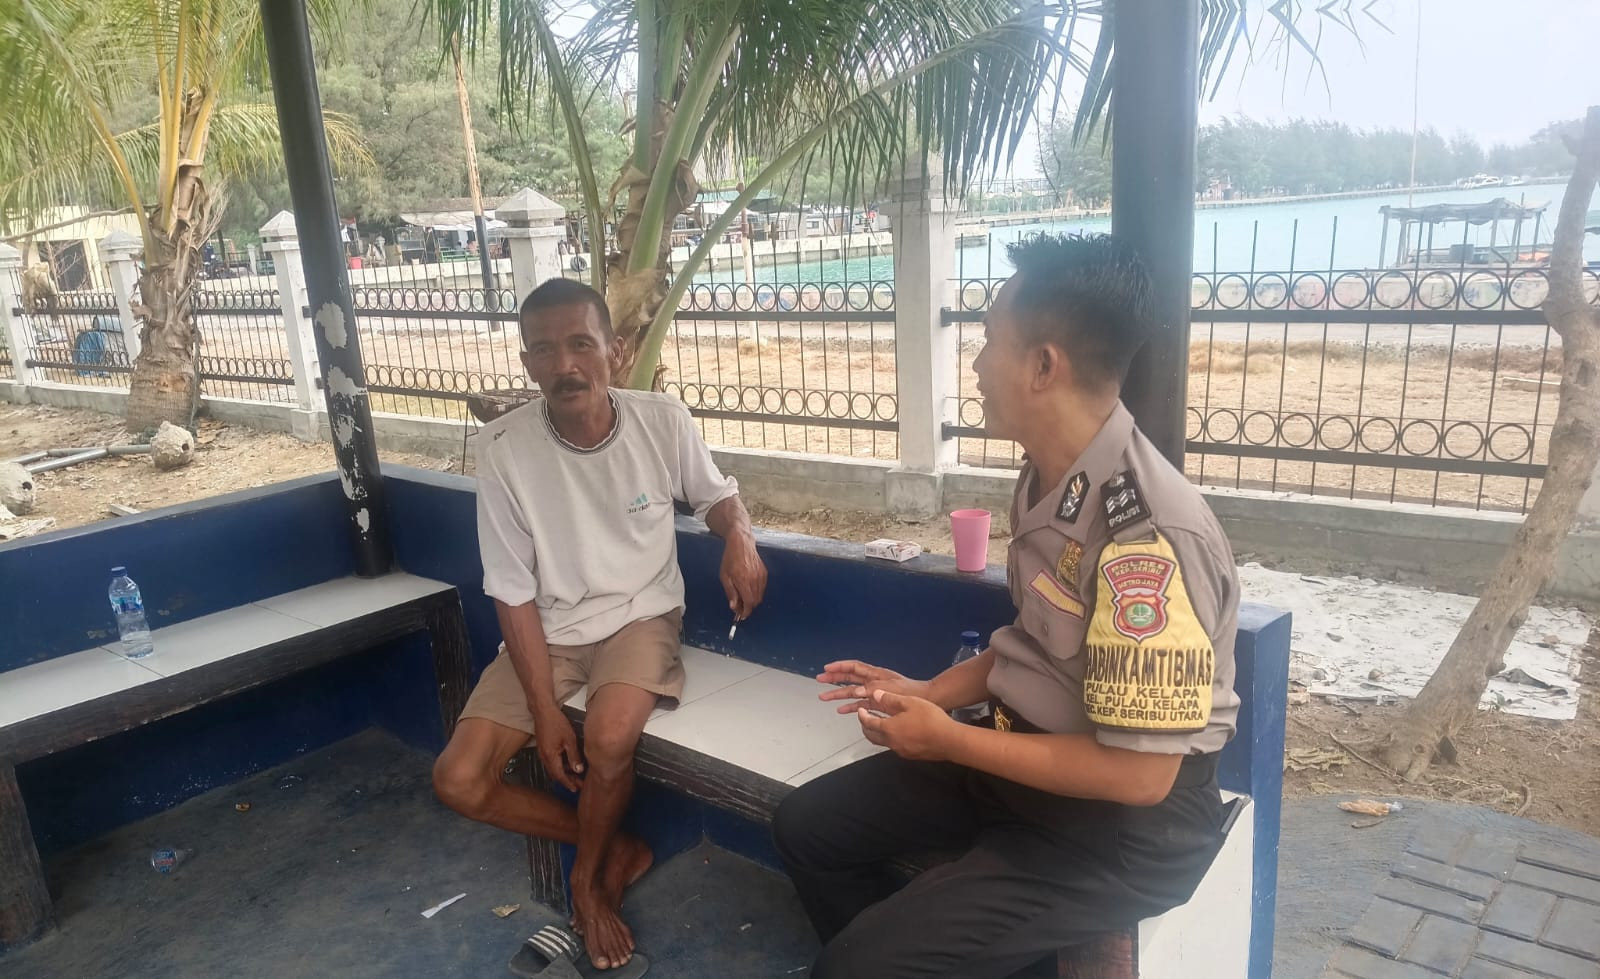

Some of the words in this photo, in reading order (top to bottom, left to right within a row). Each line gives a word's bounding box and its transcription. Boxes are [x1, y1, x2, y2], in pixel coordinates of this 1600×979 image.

[1111, 560, 1166, 573] POLRES
[1118, 579, 1141, 588] METRO
[1142, 579, 1159, 588] JAYA
[1086, 683, 1128, 697] PULAU
[1136, 687, 1199, 699] KELAPA
[1085, 693, 1102, 704] KEL.
[1105, 696, 1148, 709] PULAU
[1153, 699, 1199, 710] KELAPA
[1097, 705, 1118, 718] KEP.
[1120, 708, 1166, 721] SERIBU
[1170, 710, 1203, 721] UTARA
